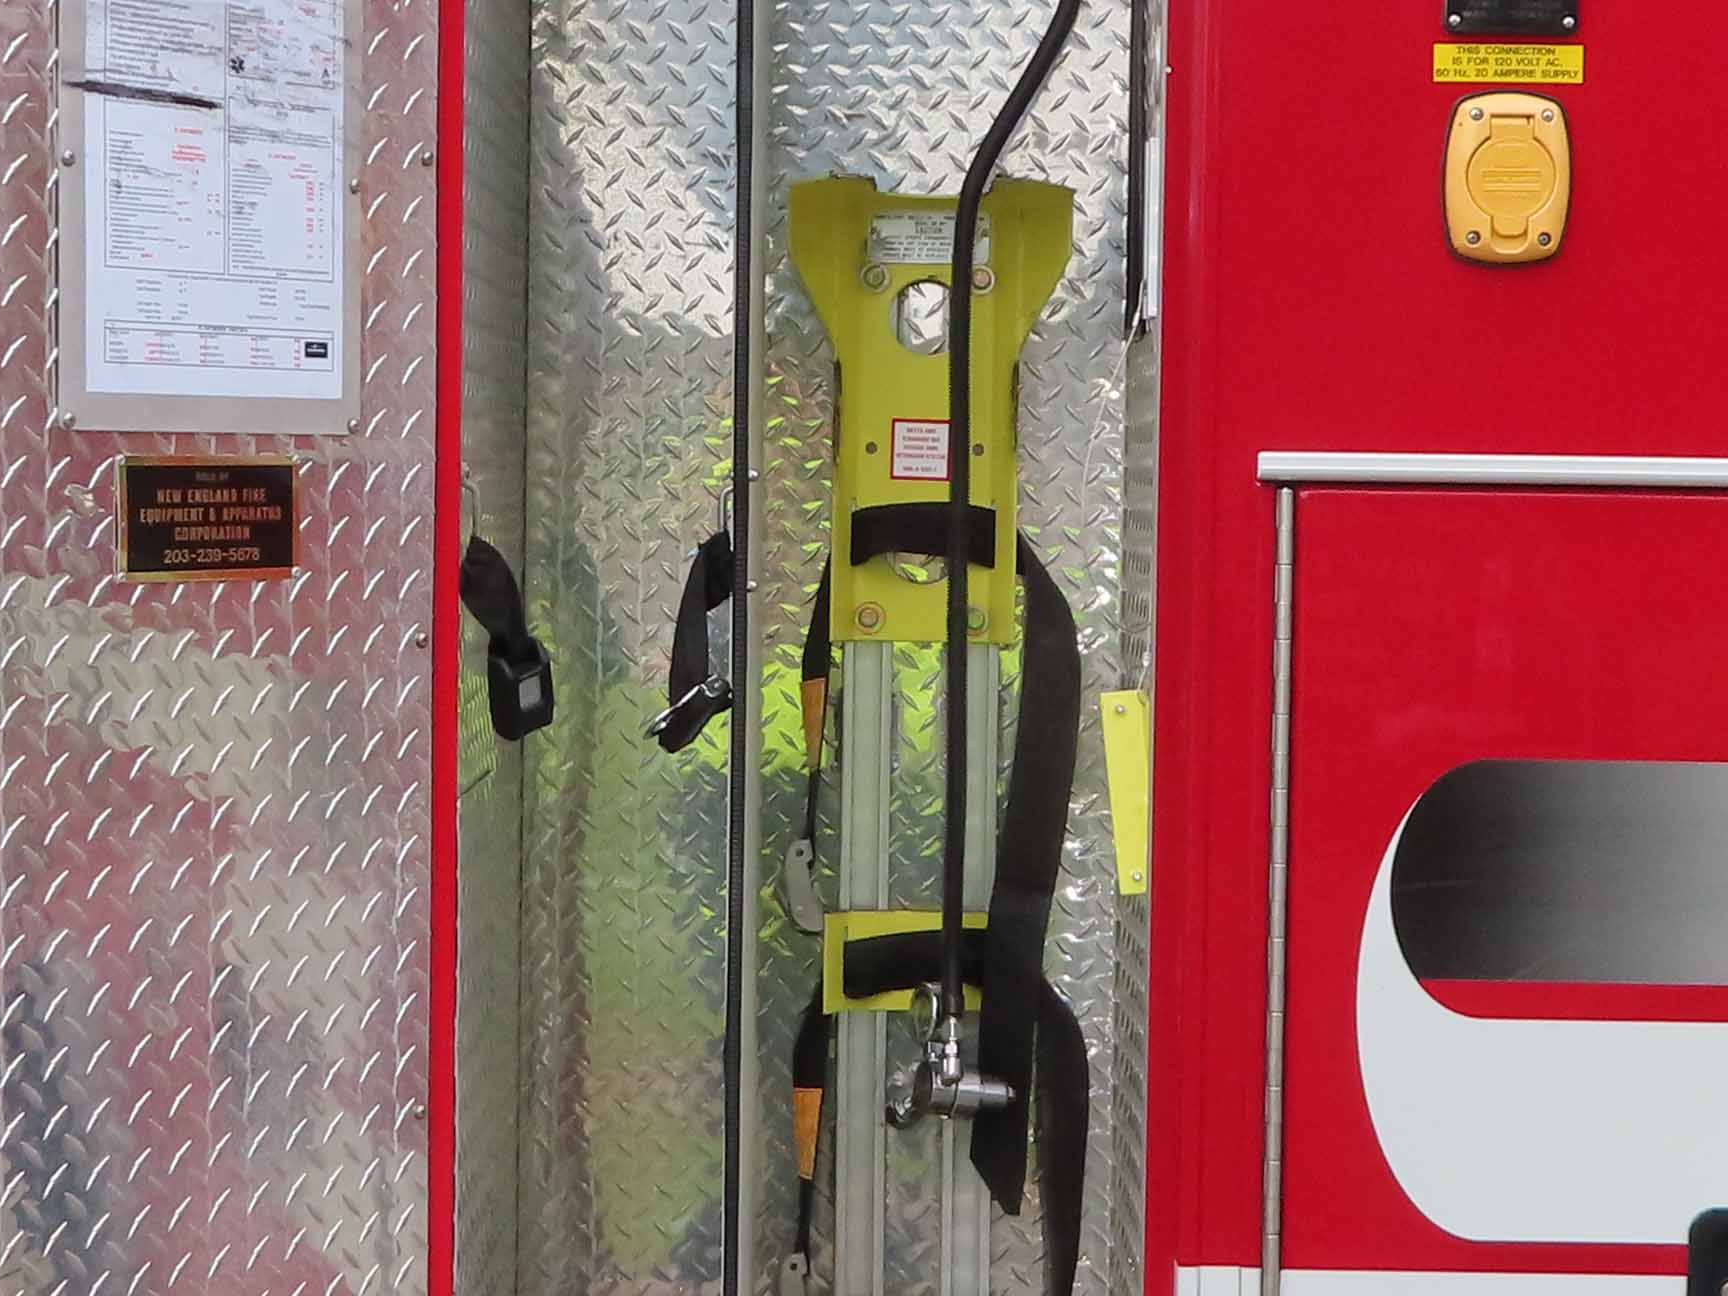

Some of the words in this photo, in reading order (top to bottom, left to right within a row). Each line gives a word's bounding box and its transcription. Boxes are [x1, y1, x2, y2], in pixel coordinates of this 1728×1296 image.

[1456, 46, 1481, 55] THIS
[1485, 46, 1556, 56] CONNECTION
[1467, 57, 1489, 66] FOR
[1494, 57, 1512, 66] 120
[1516, 57, 1541, 66] VOLT
[1474, 68, 1489, 78] 20
[1493, 68, 1536, 79] AMPERE
[1541, 69, 1579, 80] SUPPLY
[156, 488, 182, 504] NEW
[187, 488, 238, 504] ENGLAND
[139, 507, 205, 525] EQUIPMENT
[174, 526, 251, 542] CORPORATION
